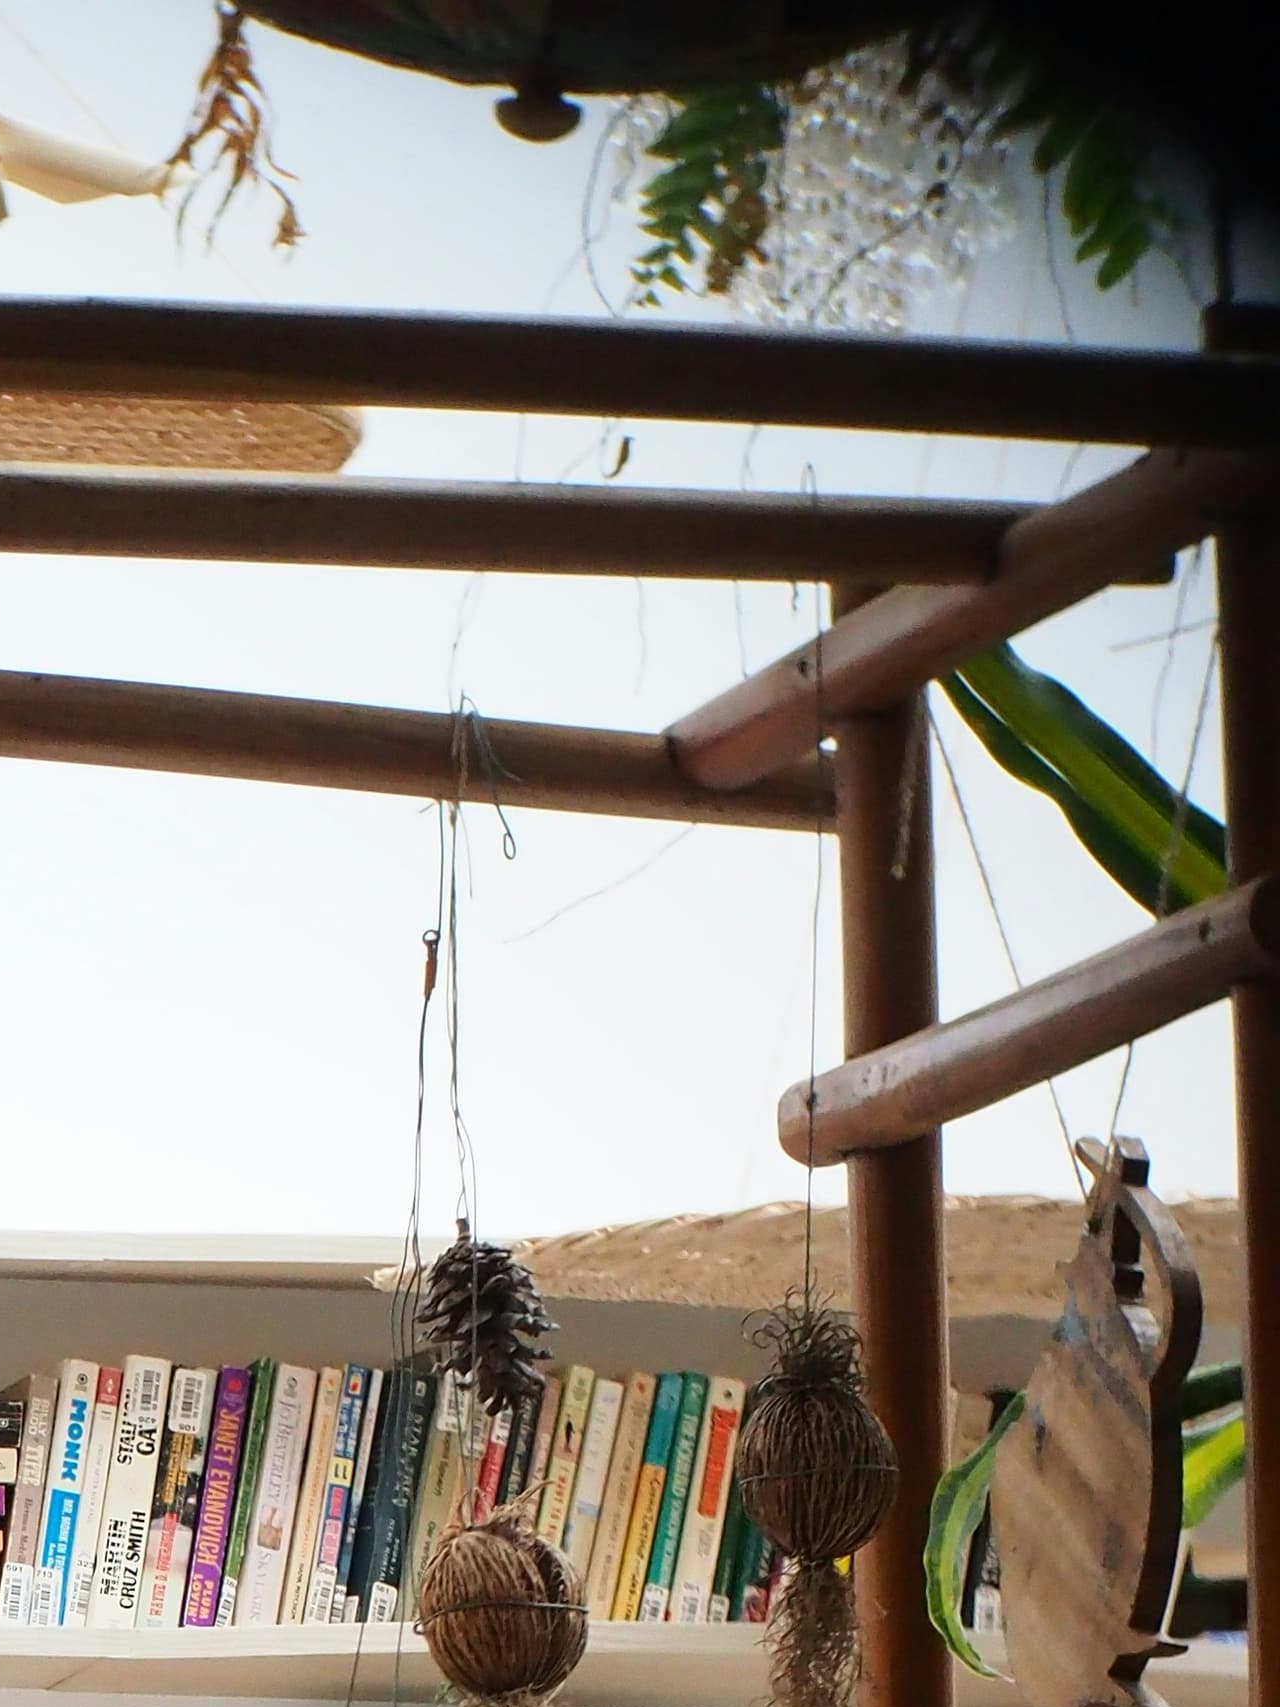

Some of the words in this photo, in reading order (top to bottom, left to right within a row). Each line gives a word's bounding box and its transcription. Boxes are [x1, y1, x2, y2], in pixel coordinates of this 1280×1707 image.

[61, 1398, 88, 1481] MONK
[212, 1409, 239, 1462] JANET
[126, 1510, 147, 1556] SMITH
[195, 1469, 233, 1572] EVANOVICH
[100, 1518, 127, 1596] MARTIN
[119, 1560, 138, 1609] CRUZ
[187, 1573, 204, 1621] LOVIN'
[201, 1580, 214, 1618] PLUM
